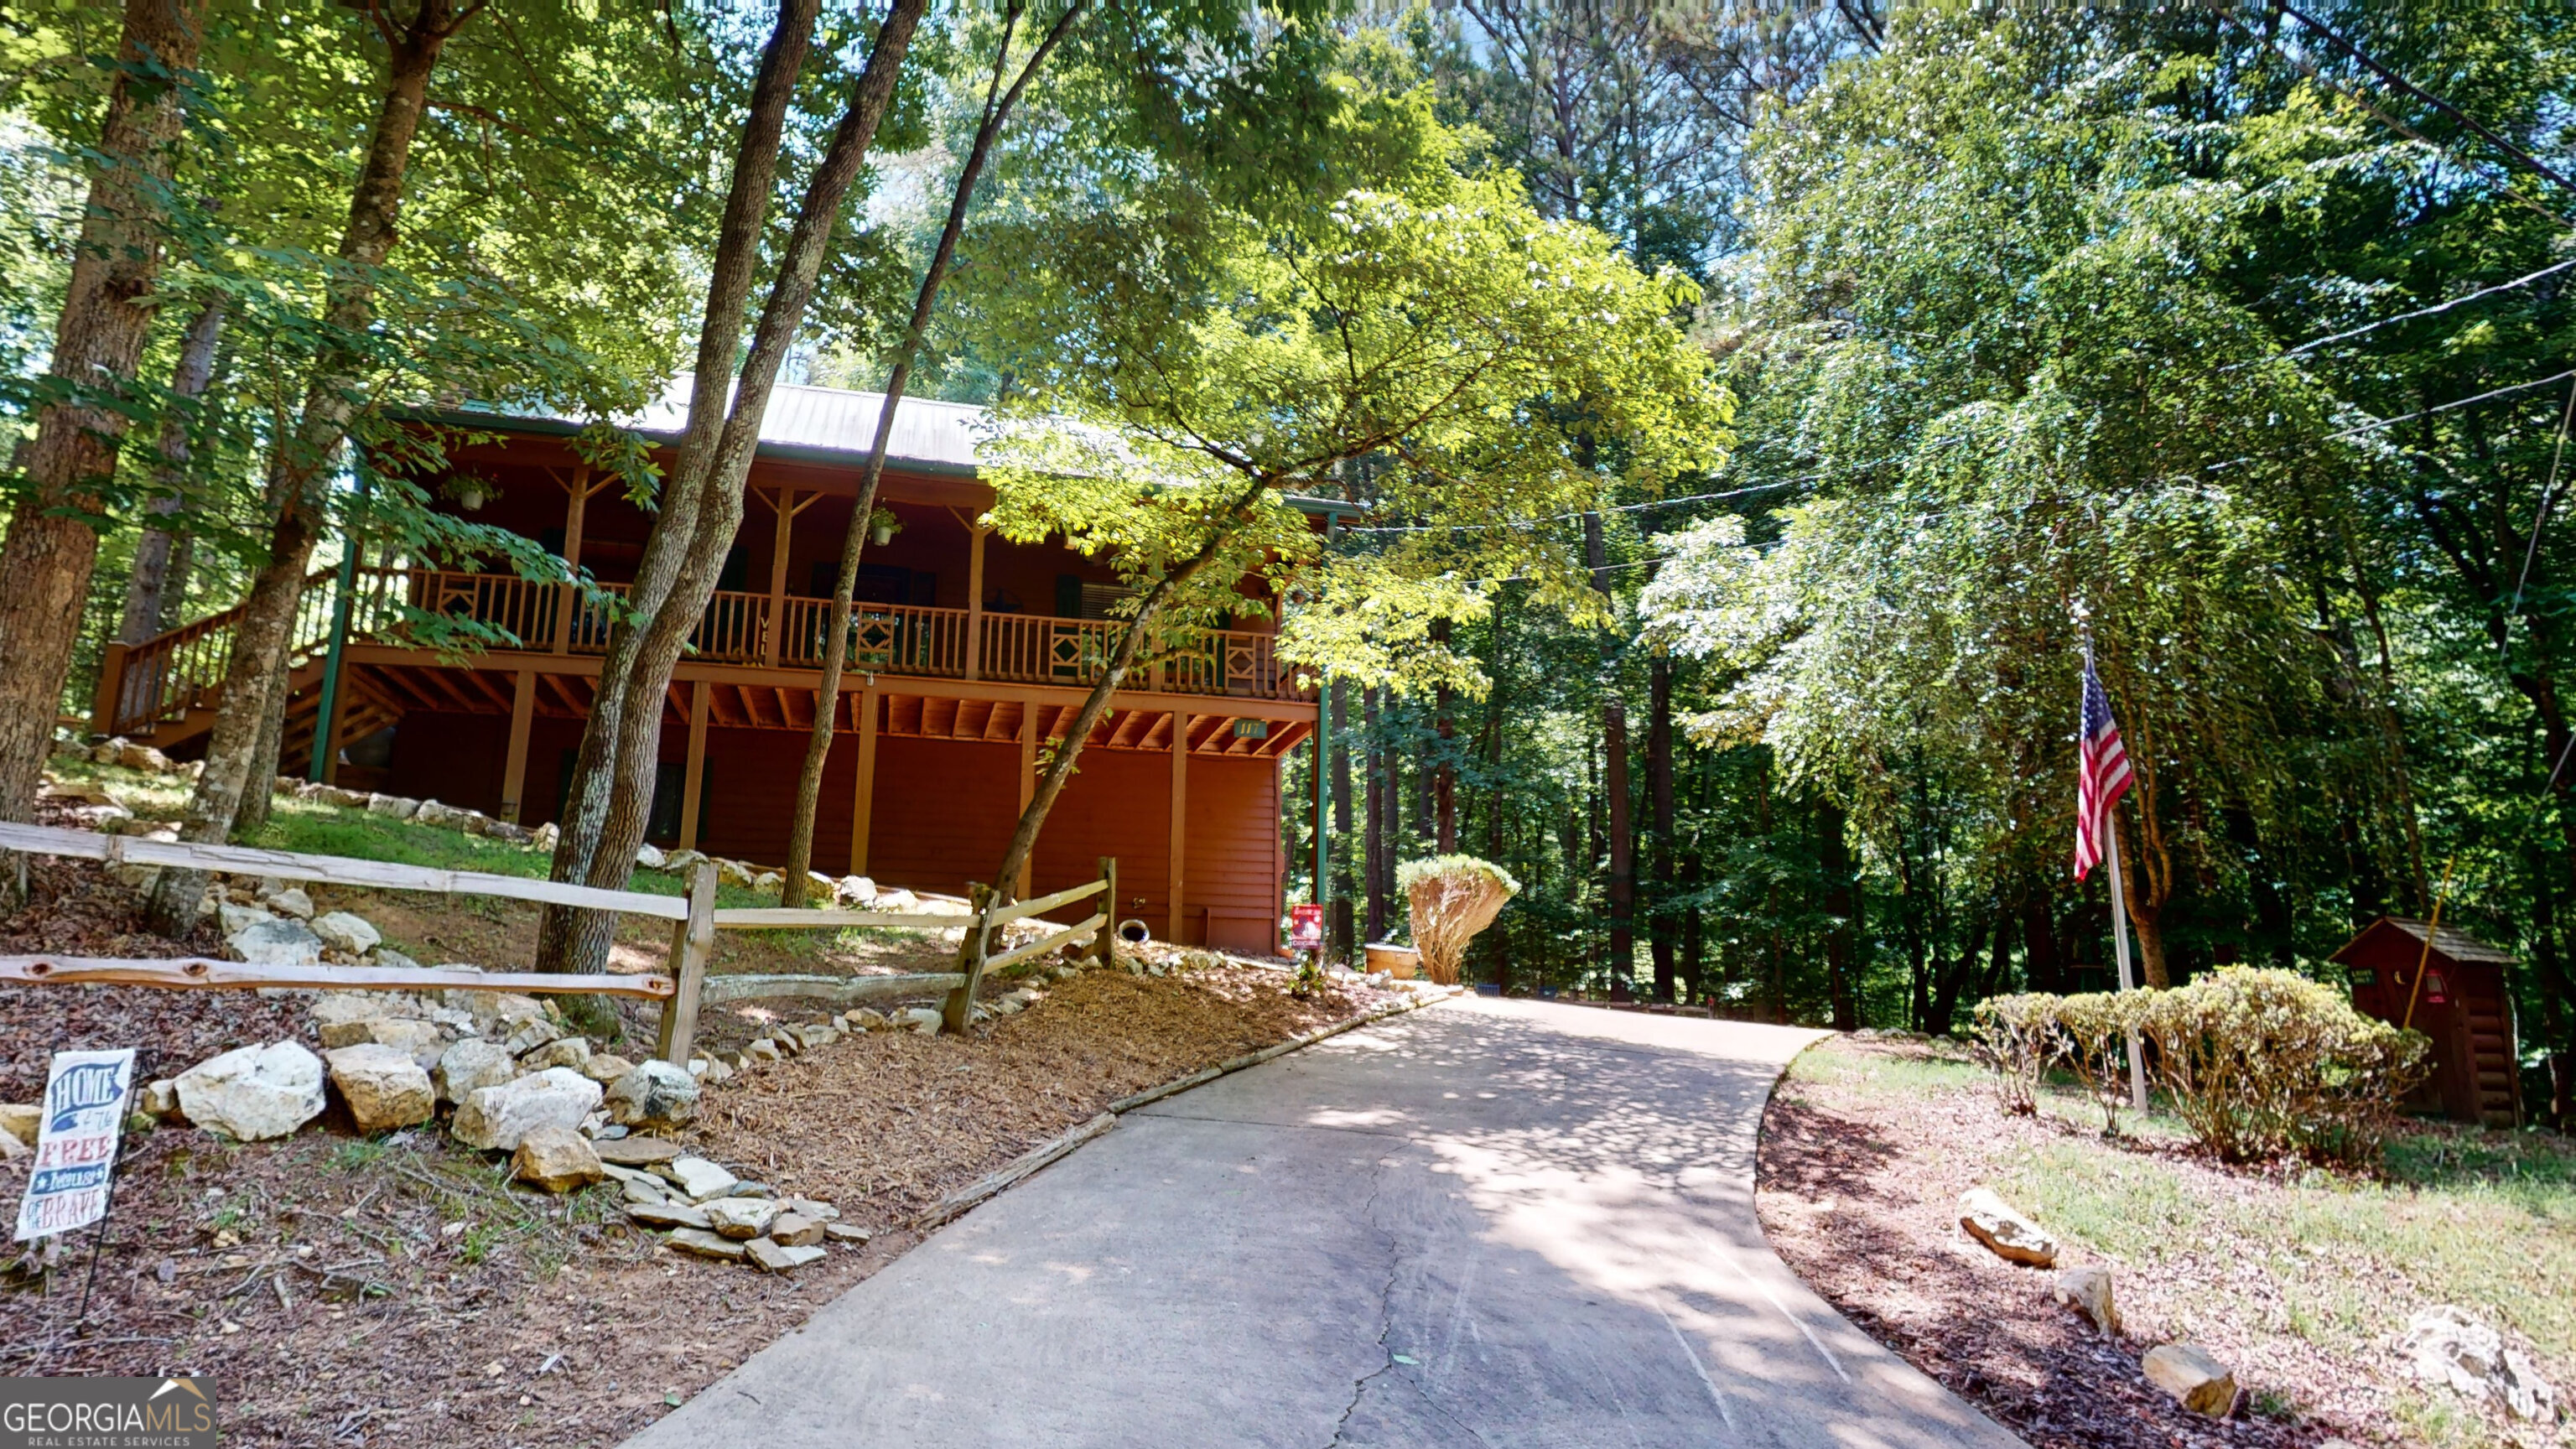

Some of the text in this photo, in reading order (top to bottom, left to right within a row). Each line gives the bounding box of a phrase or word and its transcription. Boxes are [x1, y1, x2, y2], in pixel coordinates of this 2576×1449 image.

[1240, 722, 1260, 735] 117
[54, 1066, 116, 1117] HOME
[39, 1135, 111, 1167] FREE
[42, 1188, 100, 1229] BRAVE
